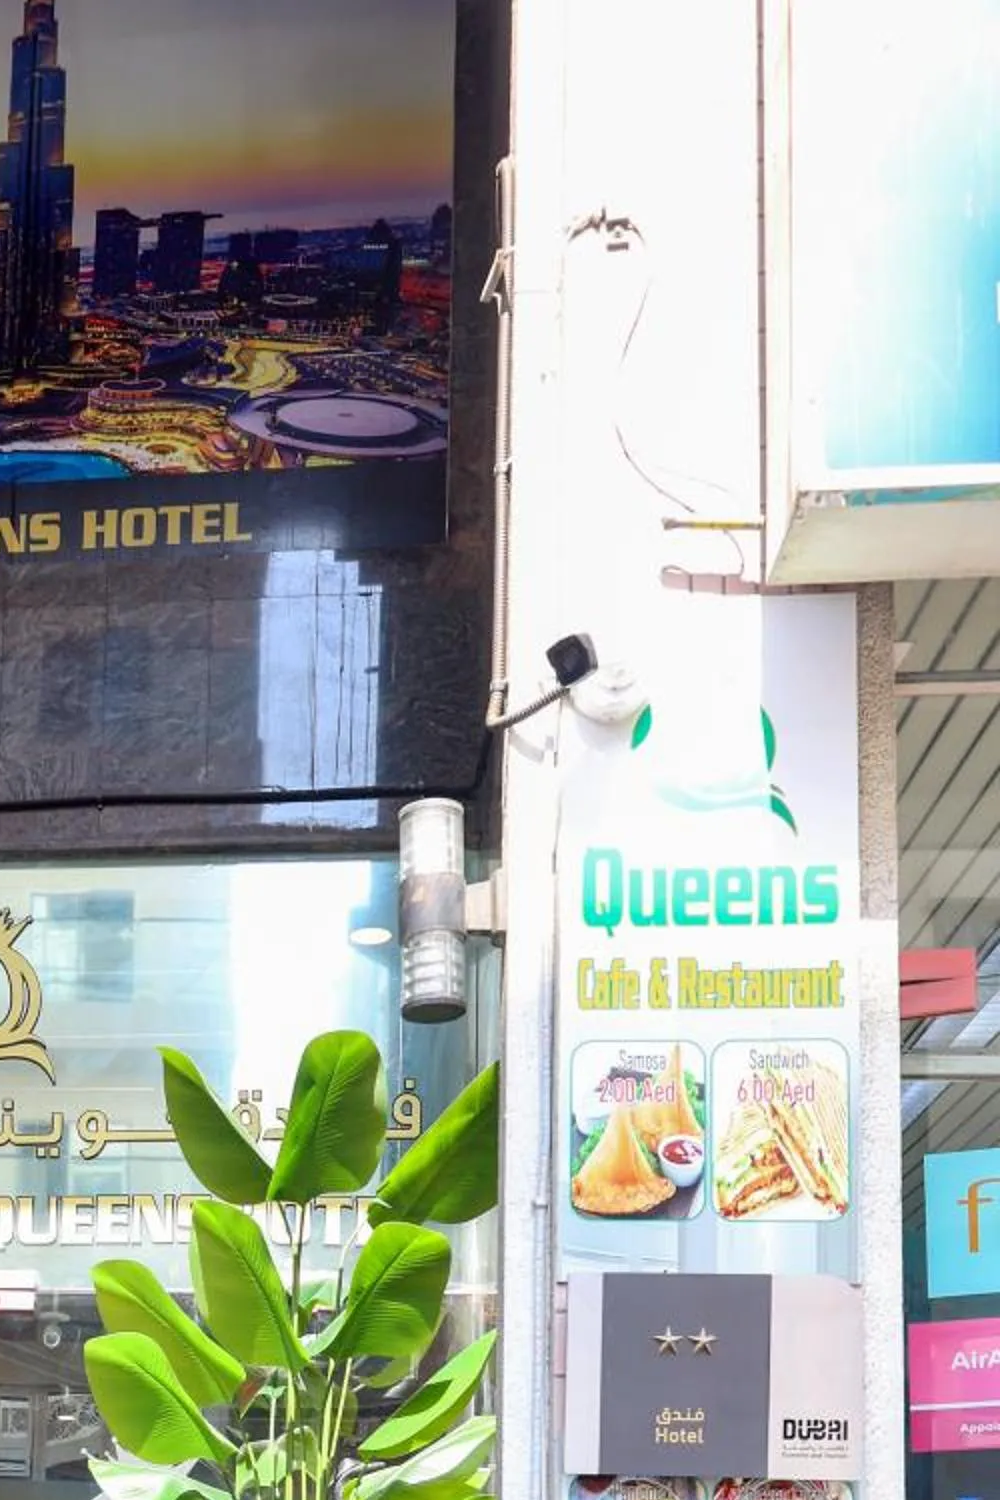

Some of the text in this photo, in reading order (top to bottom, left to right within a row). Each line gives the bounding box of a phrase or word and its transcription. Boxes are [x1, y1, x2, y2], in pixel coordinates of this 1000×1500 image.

[81, 503, 253, 550] HOTEL
[582, 847, 839, 937] Queens
[578, 956, 845, 1009] Cafe & Restaurant
[618, 1049, 667, 1070] Samosa
[749, 1049, 810, 1070] Sandwich
[642, 1080, 676, 1103] Aed
[782, 1080, 815, 1103] Aed
[655, 1407, 705, 1425] فندق
[655, 1427, 705, 1444] Hotel
[783, 1419, 849, 1441] DUBAI
